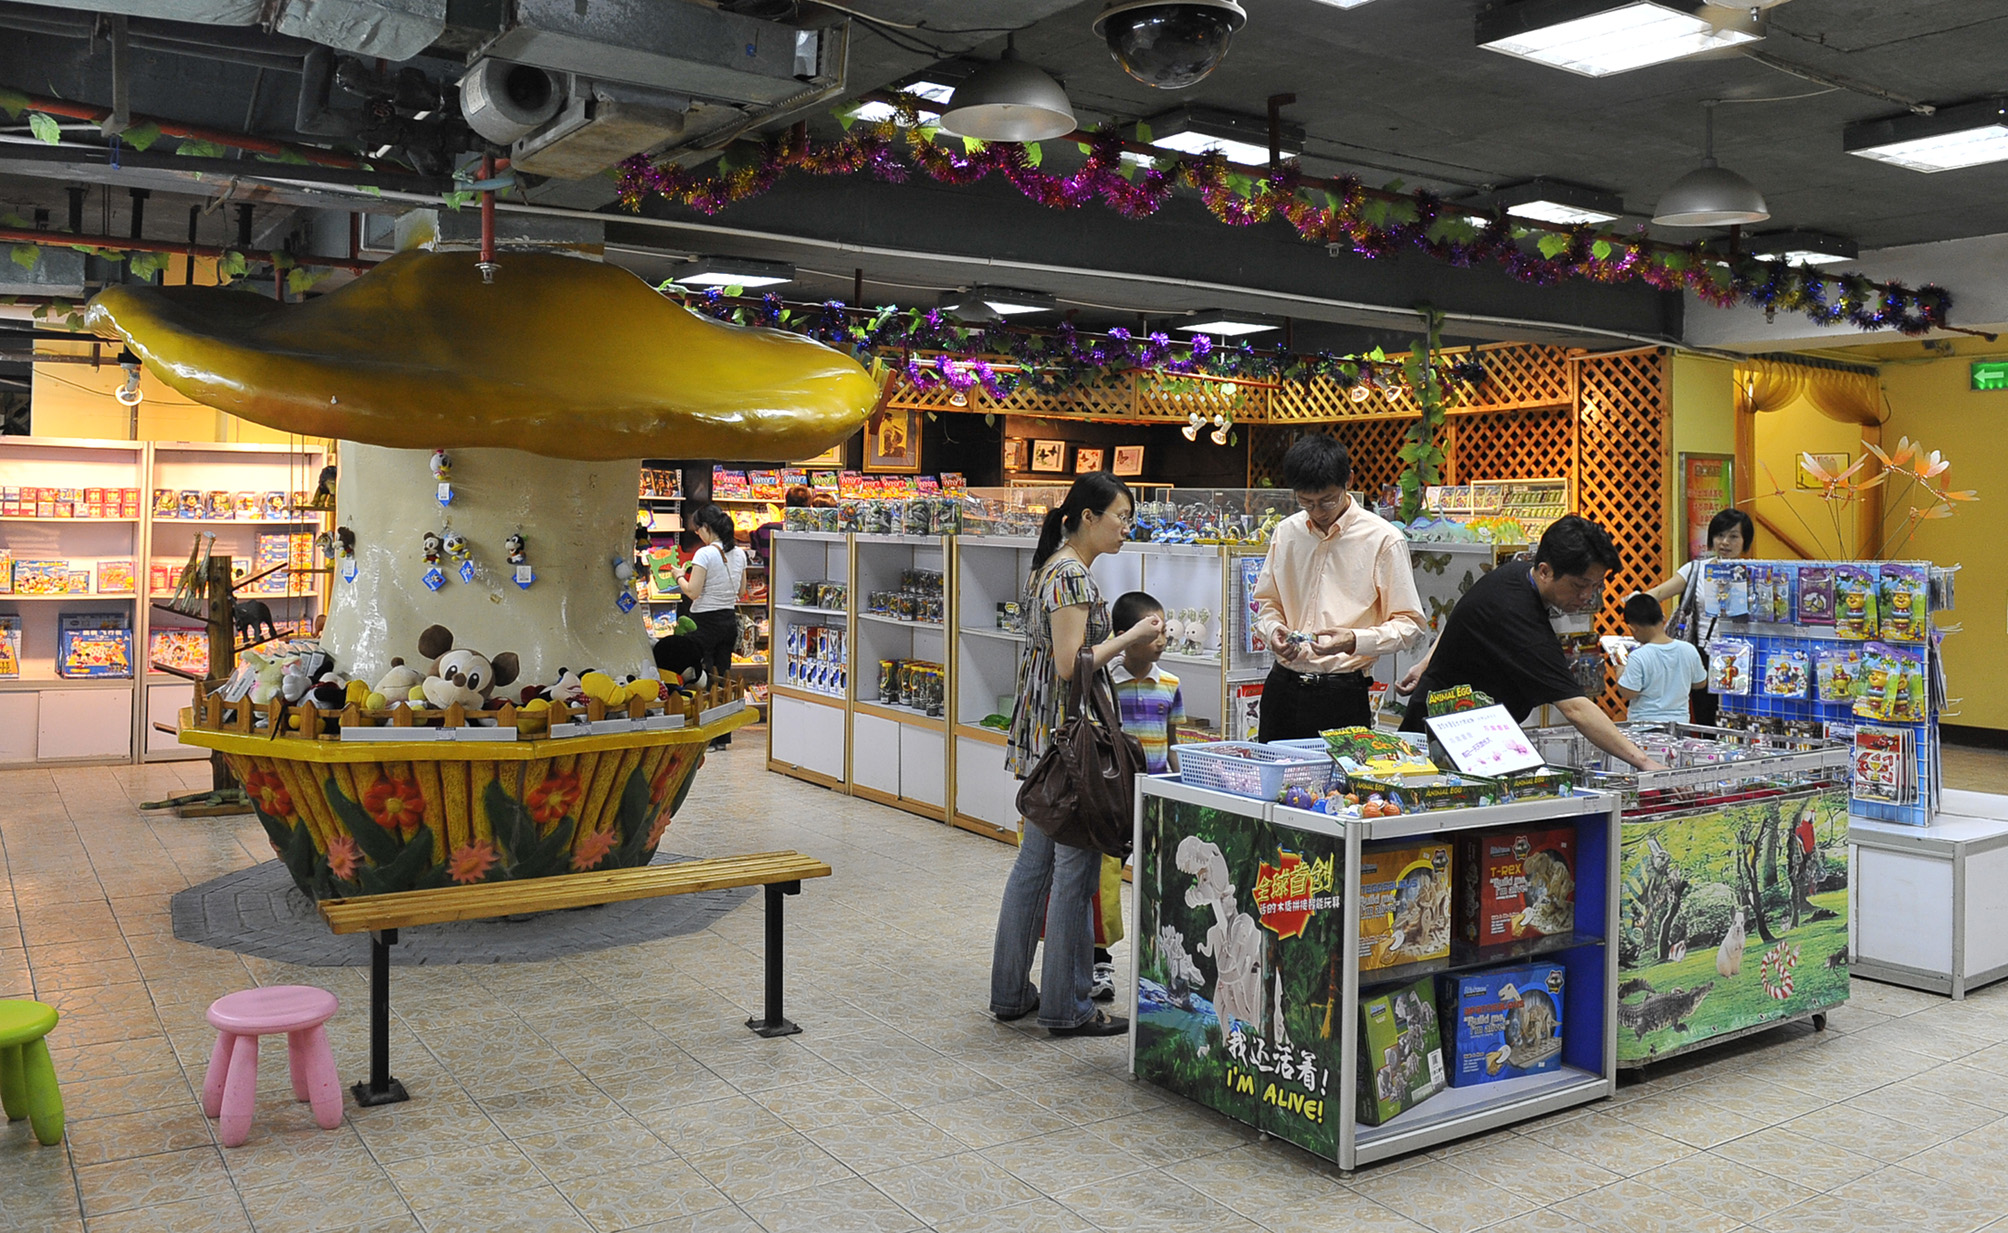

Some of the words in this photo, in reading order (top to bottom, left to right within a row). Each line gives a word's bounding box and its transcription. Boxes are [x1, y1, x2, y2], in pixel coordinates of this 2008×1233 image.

[752, 475, 776, 484] Why?
[784, 474, 807, 484] Why?
[812, 475, 836, 485] Why?
[839, 475, 862, 485] Why?
[1428, 690, 1455, 705] ANIMAL
[1456, 685, 1472, 699] EGG
[1356, 781, 1375, 791] ANIMAL
[1375, 783, 1386, 792] EGG
[1513, 778, 1534, 788] ANIMAL
[1535, 777, 1545, 785] EGG
[1425, 787, 1449, 797] ANIMAL
[1450, 786, 1463, 795] EGG
[1256, 852, 1335, 902] 全球首创
[1360, 877, 1419, 894] TEGOSAURUS
[1226, 1065, 1255, 1096] I'M
[1262, 1082, 1324, 1124] ALIVE!
